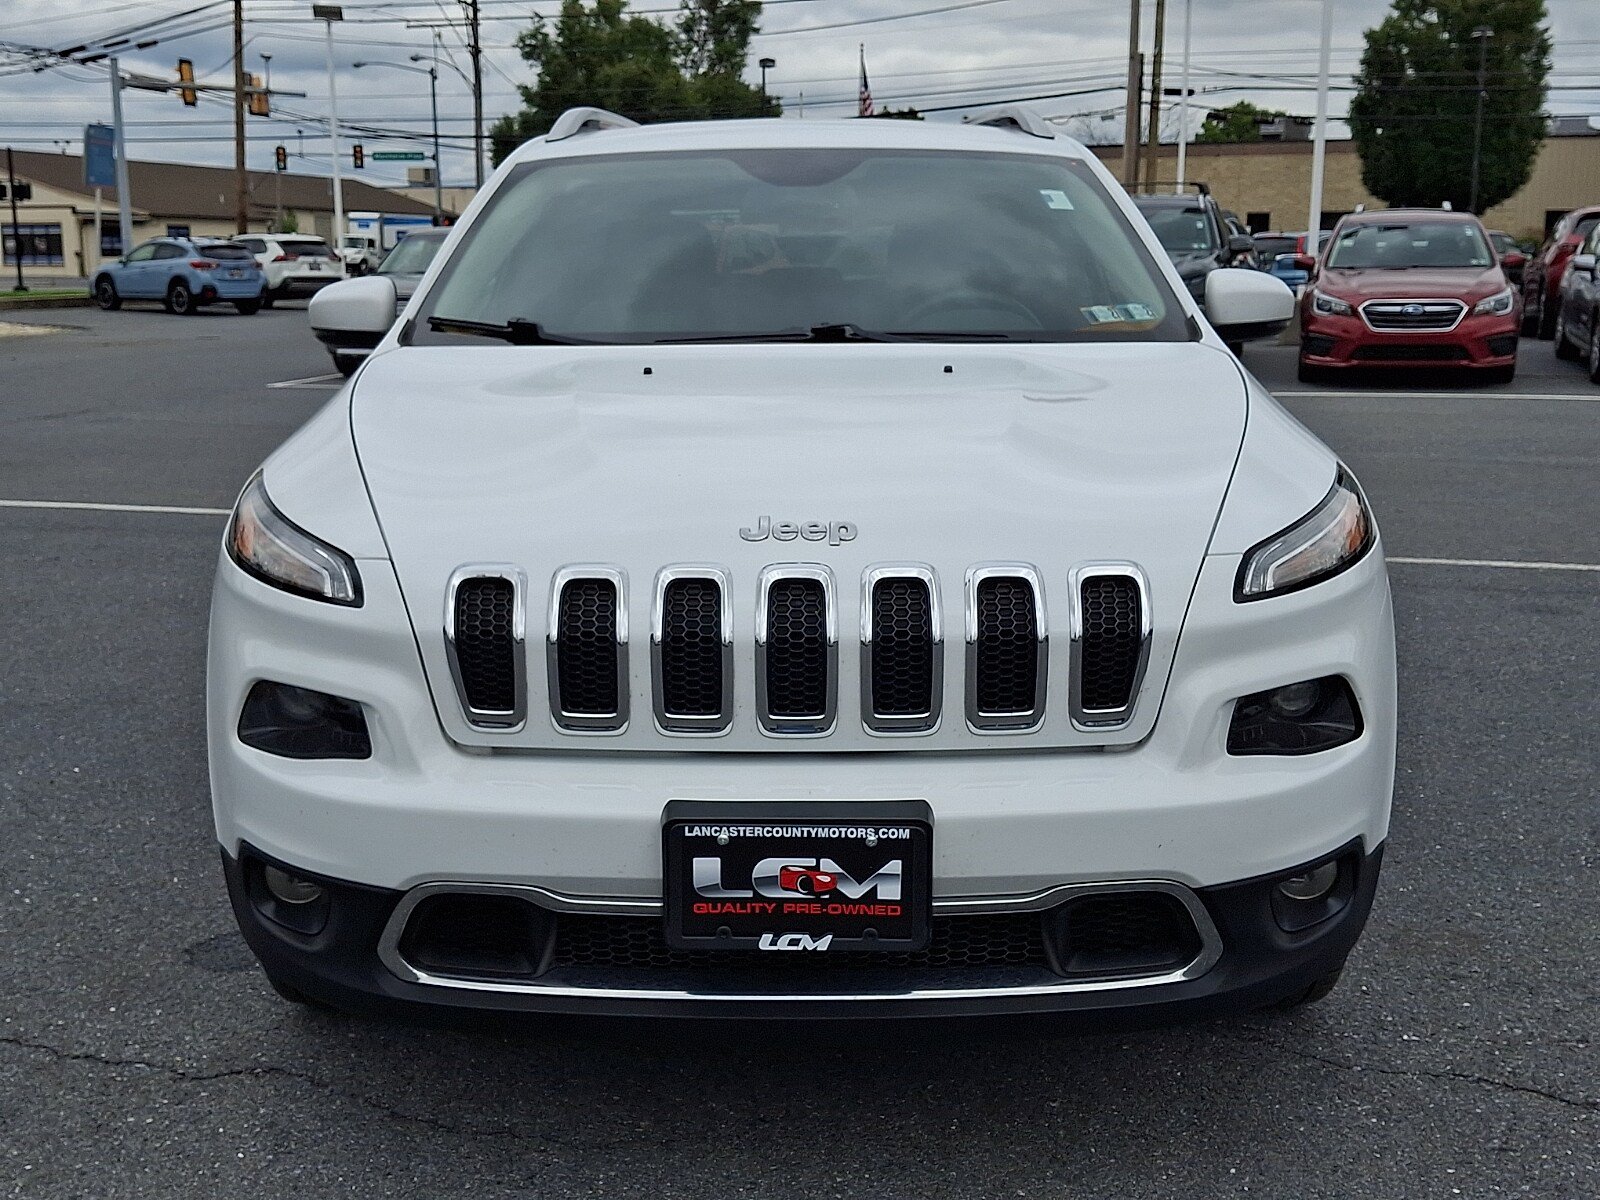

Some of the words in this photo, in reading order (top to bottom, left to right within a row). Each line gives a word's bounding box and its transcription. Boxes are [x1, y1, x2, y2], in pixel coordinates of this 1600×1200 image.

[739, 515, 858, 546] Jeep
[684, 826, 910, 839] LANCASTERCOUNTYMOTORS.COM
[692, 857, 902, 900] LCM
[693, 902, 776, 914] QUALITY
[784, 903, 901, 916] PRE-OWNED
[758, 933, 832, 951] LCM
